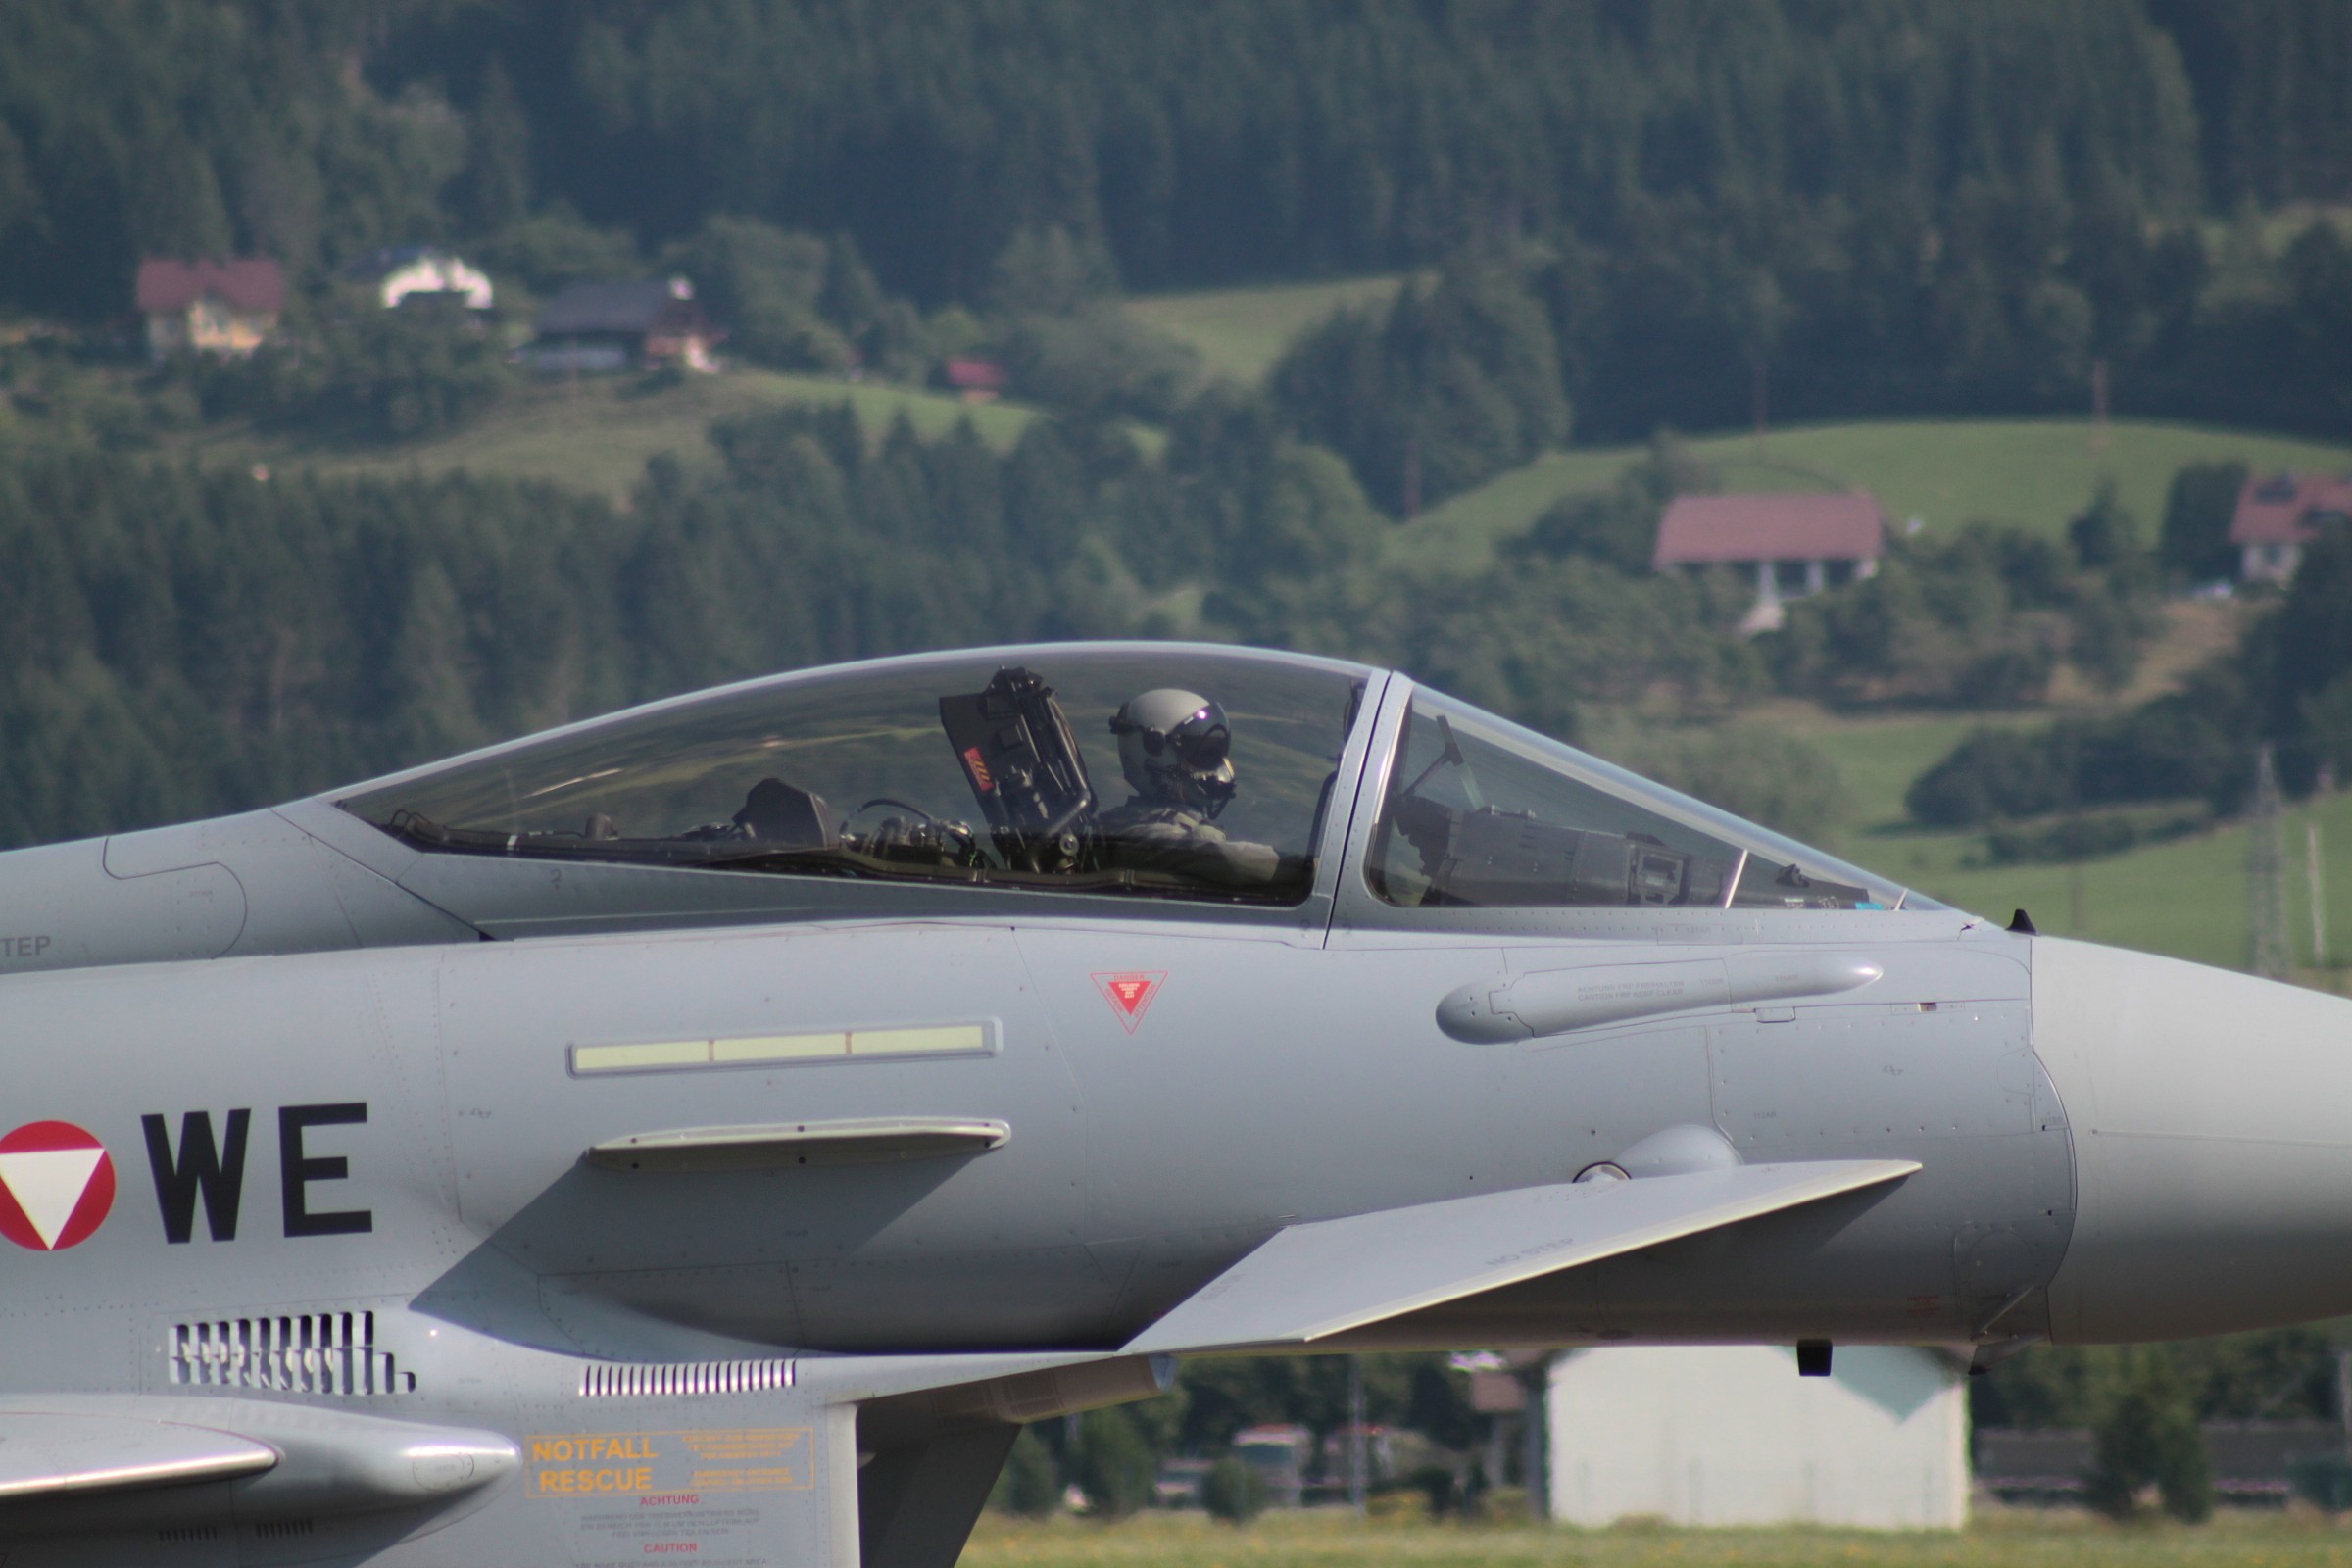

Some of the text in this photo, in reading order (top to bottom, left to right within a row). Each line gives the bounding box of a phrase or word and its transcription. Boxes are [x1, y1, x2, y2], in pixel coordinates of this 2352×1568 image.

[0, 935, 51, 957] TEP
[1577, 992, 1614, 1001] CAUTION
[1633, 989, 1654, 998] KEEP
[141, 1102, 372, 1244] WE
[532, 1438, 659, 1462] NOTFALL
[540, 1467, 653, 1492] RESCUE
[639, 1494, 700, 1506] ACHTUNG
[643, 1543, 698, 1554] CAUTION
